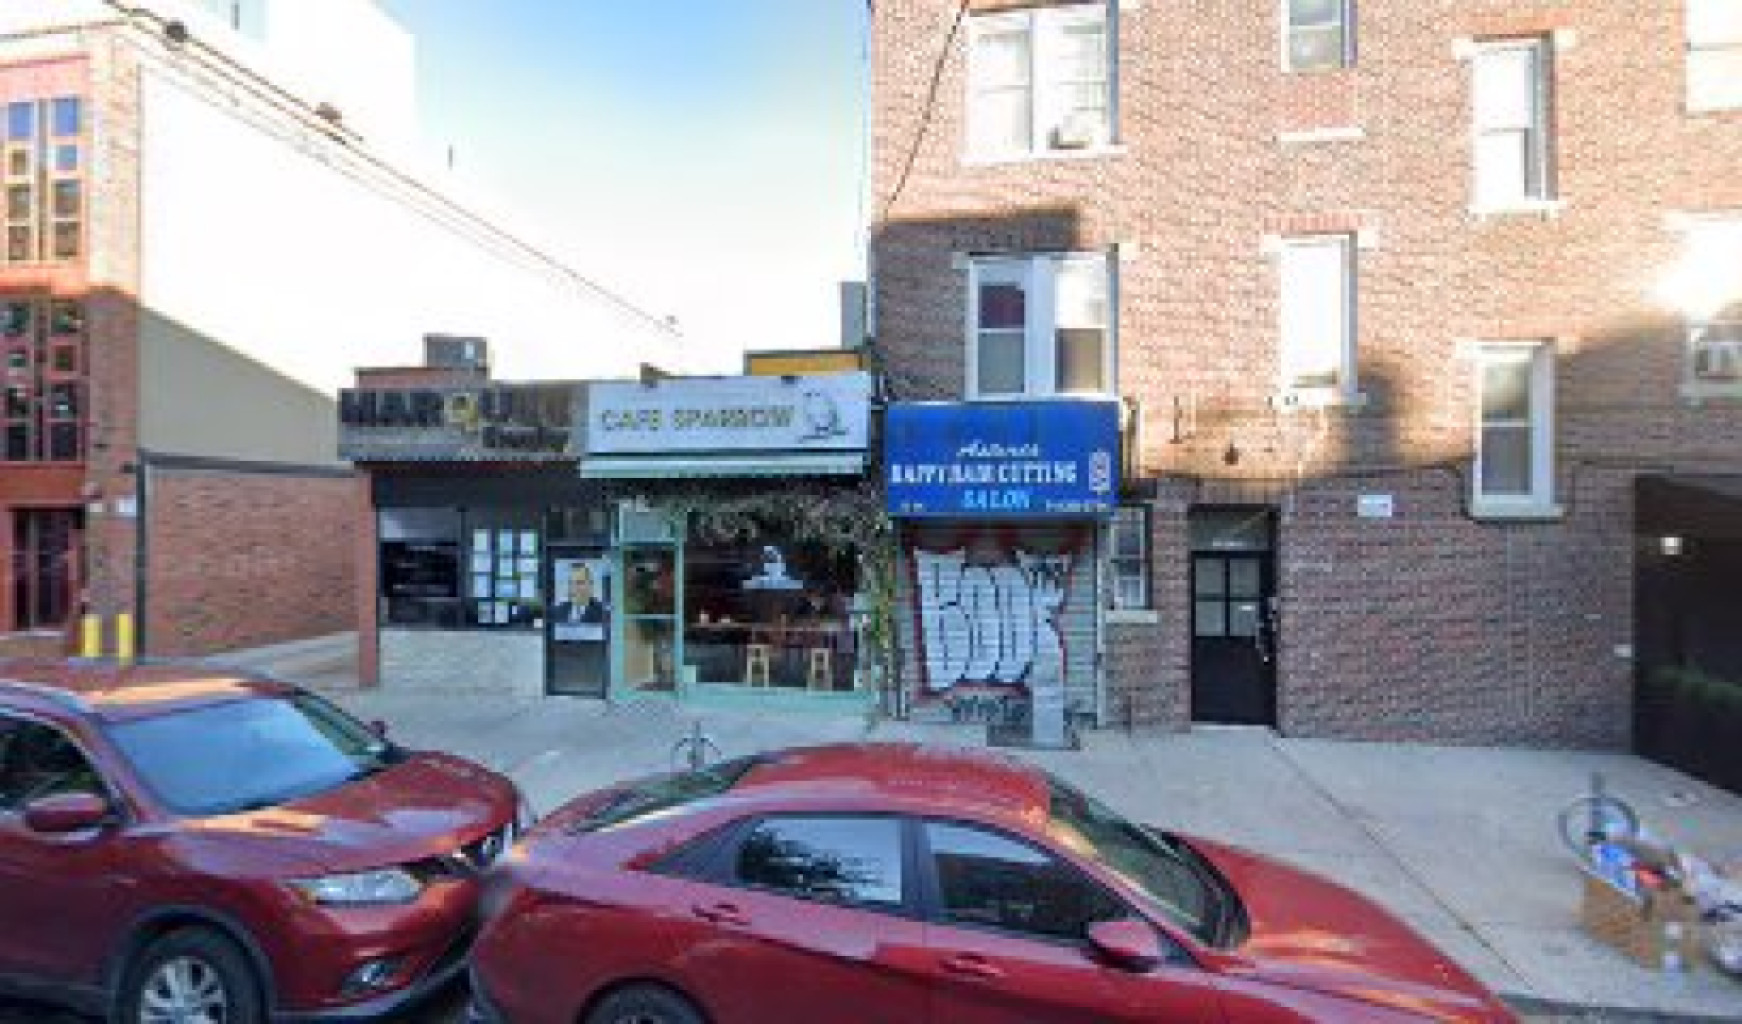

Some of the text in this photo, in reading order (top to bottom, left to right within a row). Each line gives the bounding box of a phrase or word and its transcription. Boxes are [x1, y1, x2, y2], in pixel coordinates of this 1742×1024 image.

[673, 404, 795, 429] SPARROW
[998, 460, 1077, 483] CUTTING
[962, 489, 1032, 510] SALON
